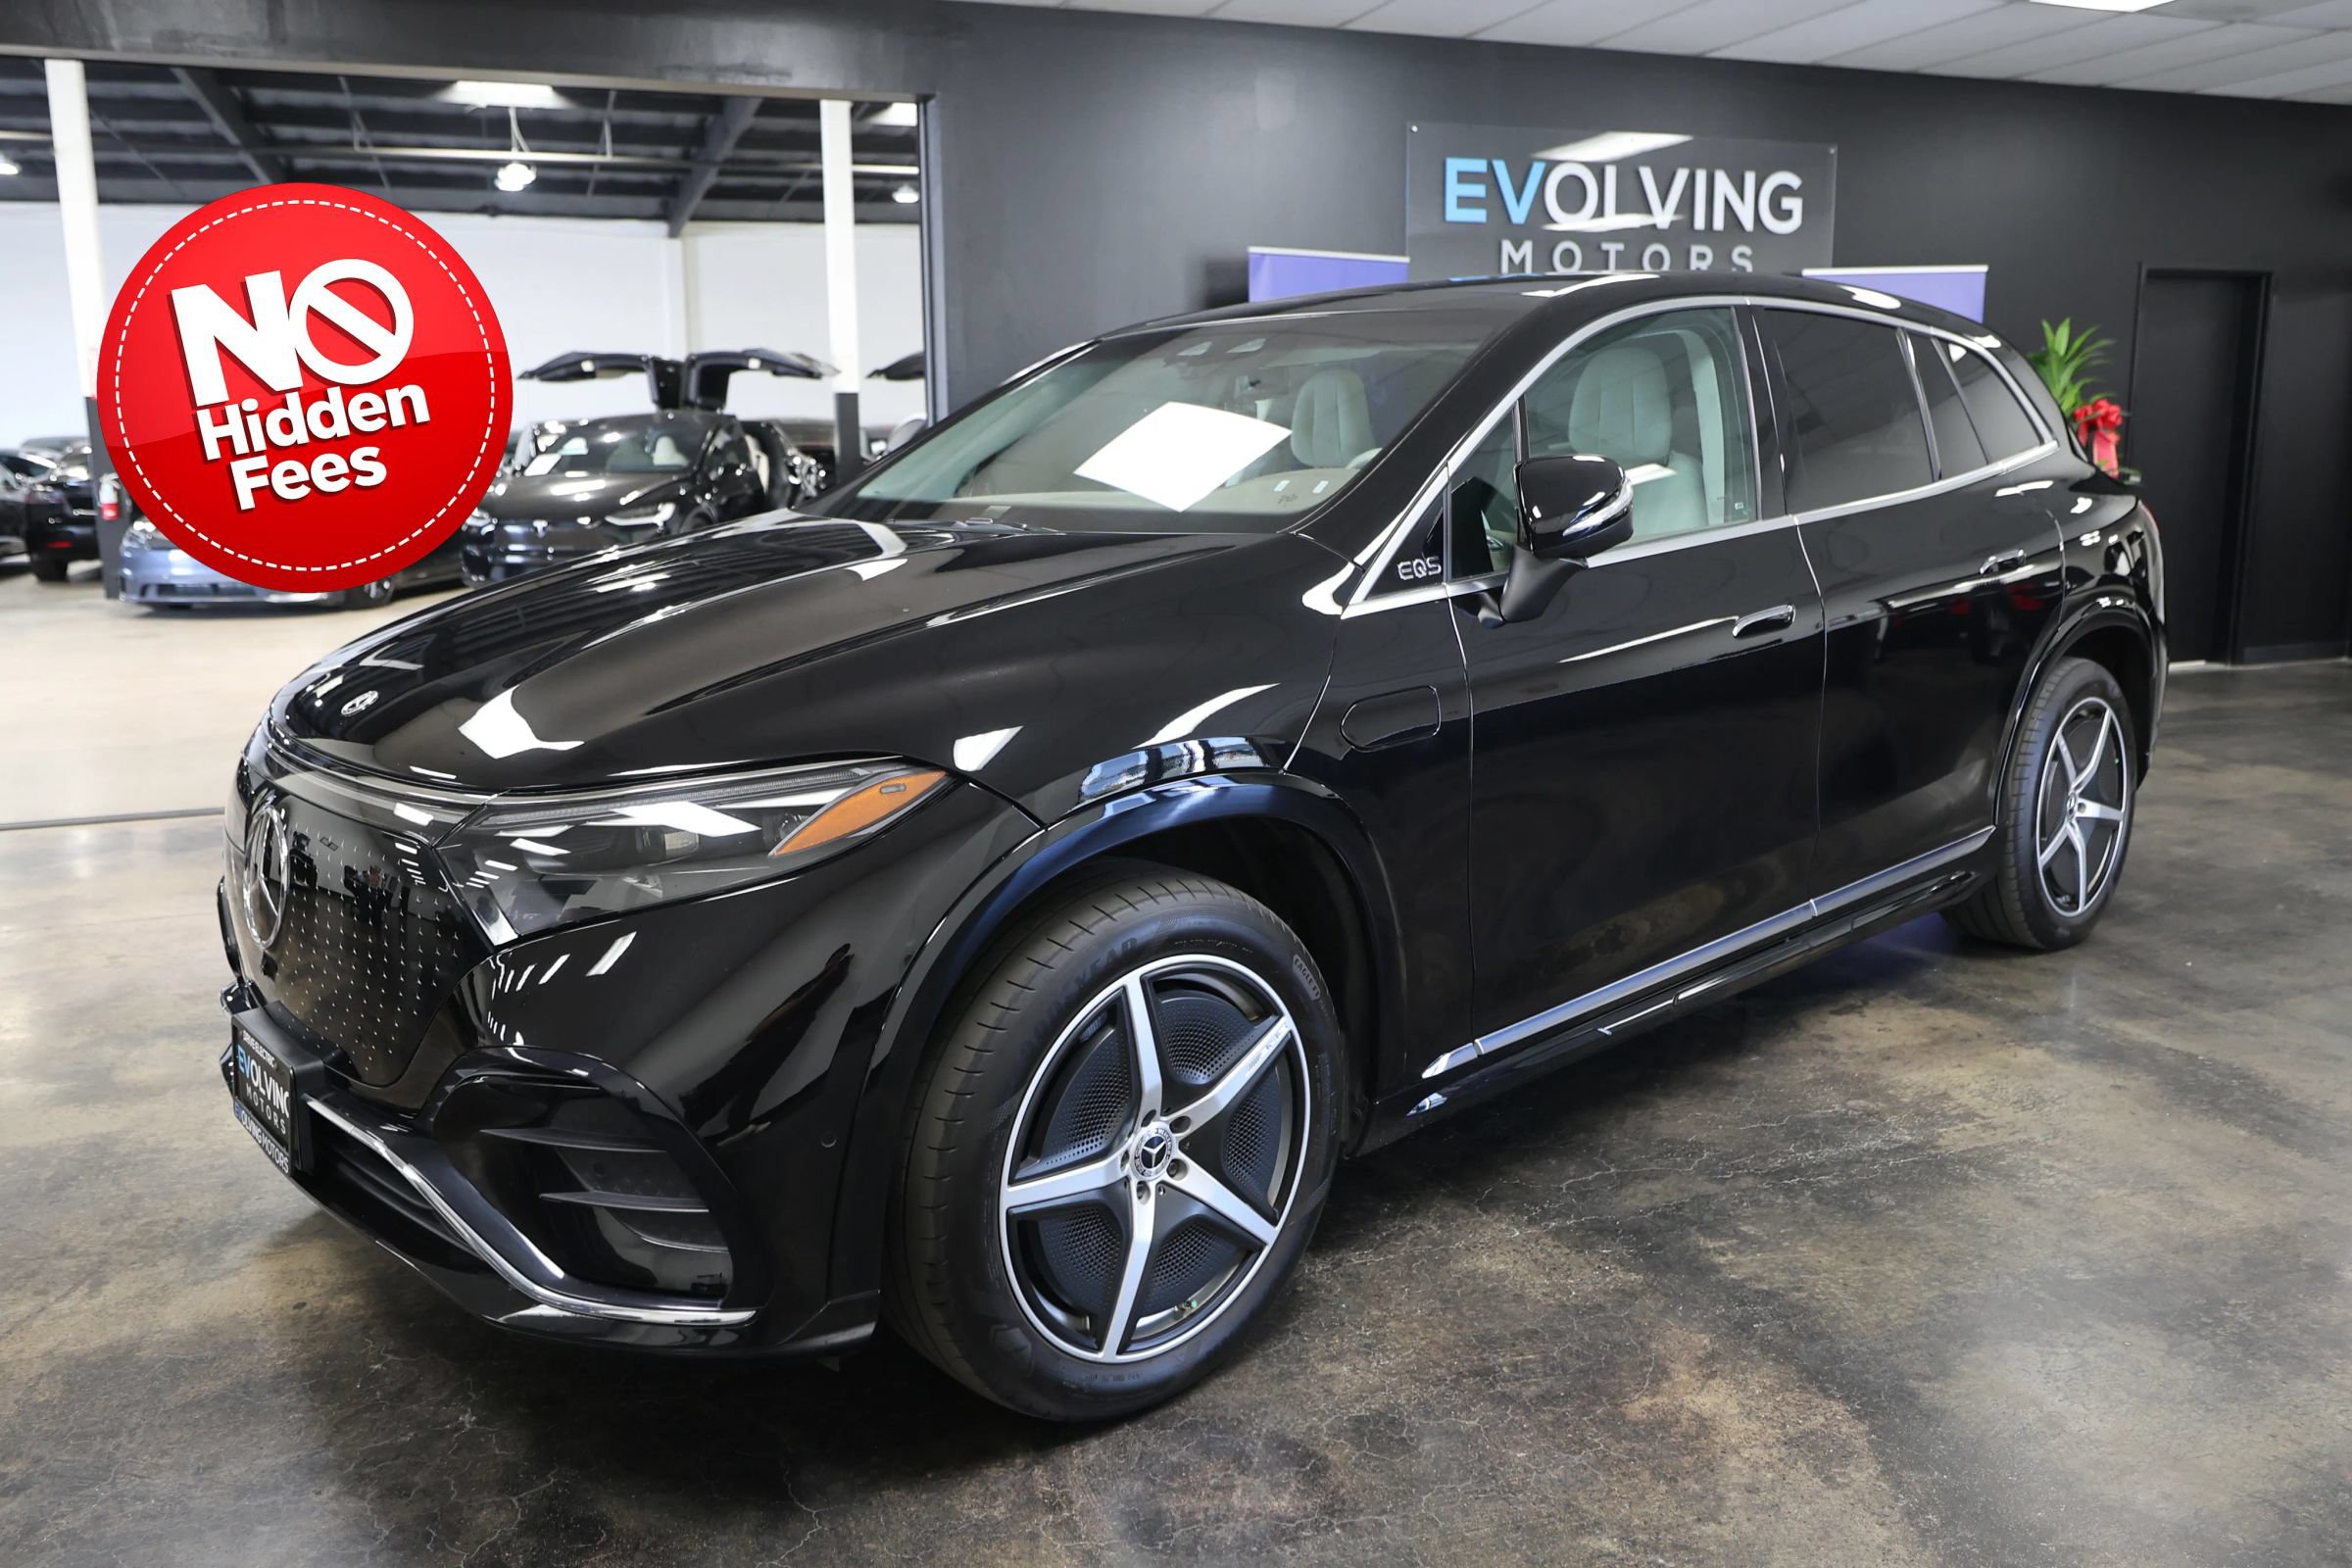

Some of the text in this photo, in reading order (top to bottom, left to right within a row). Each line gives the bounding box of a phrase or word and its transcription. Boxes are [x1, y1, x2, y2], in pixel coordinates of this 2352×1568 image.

[1444, 157, 1803, 234] EVOLVING
[1500, 240, 1754, 274] MOTORS
[1396, 556, 1442, 580] EQS
[245, 1082, 286, 1135] MOTORS
[262, 1133, 289, 1173] MOTORS
